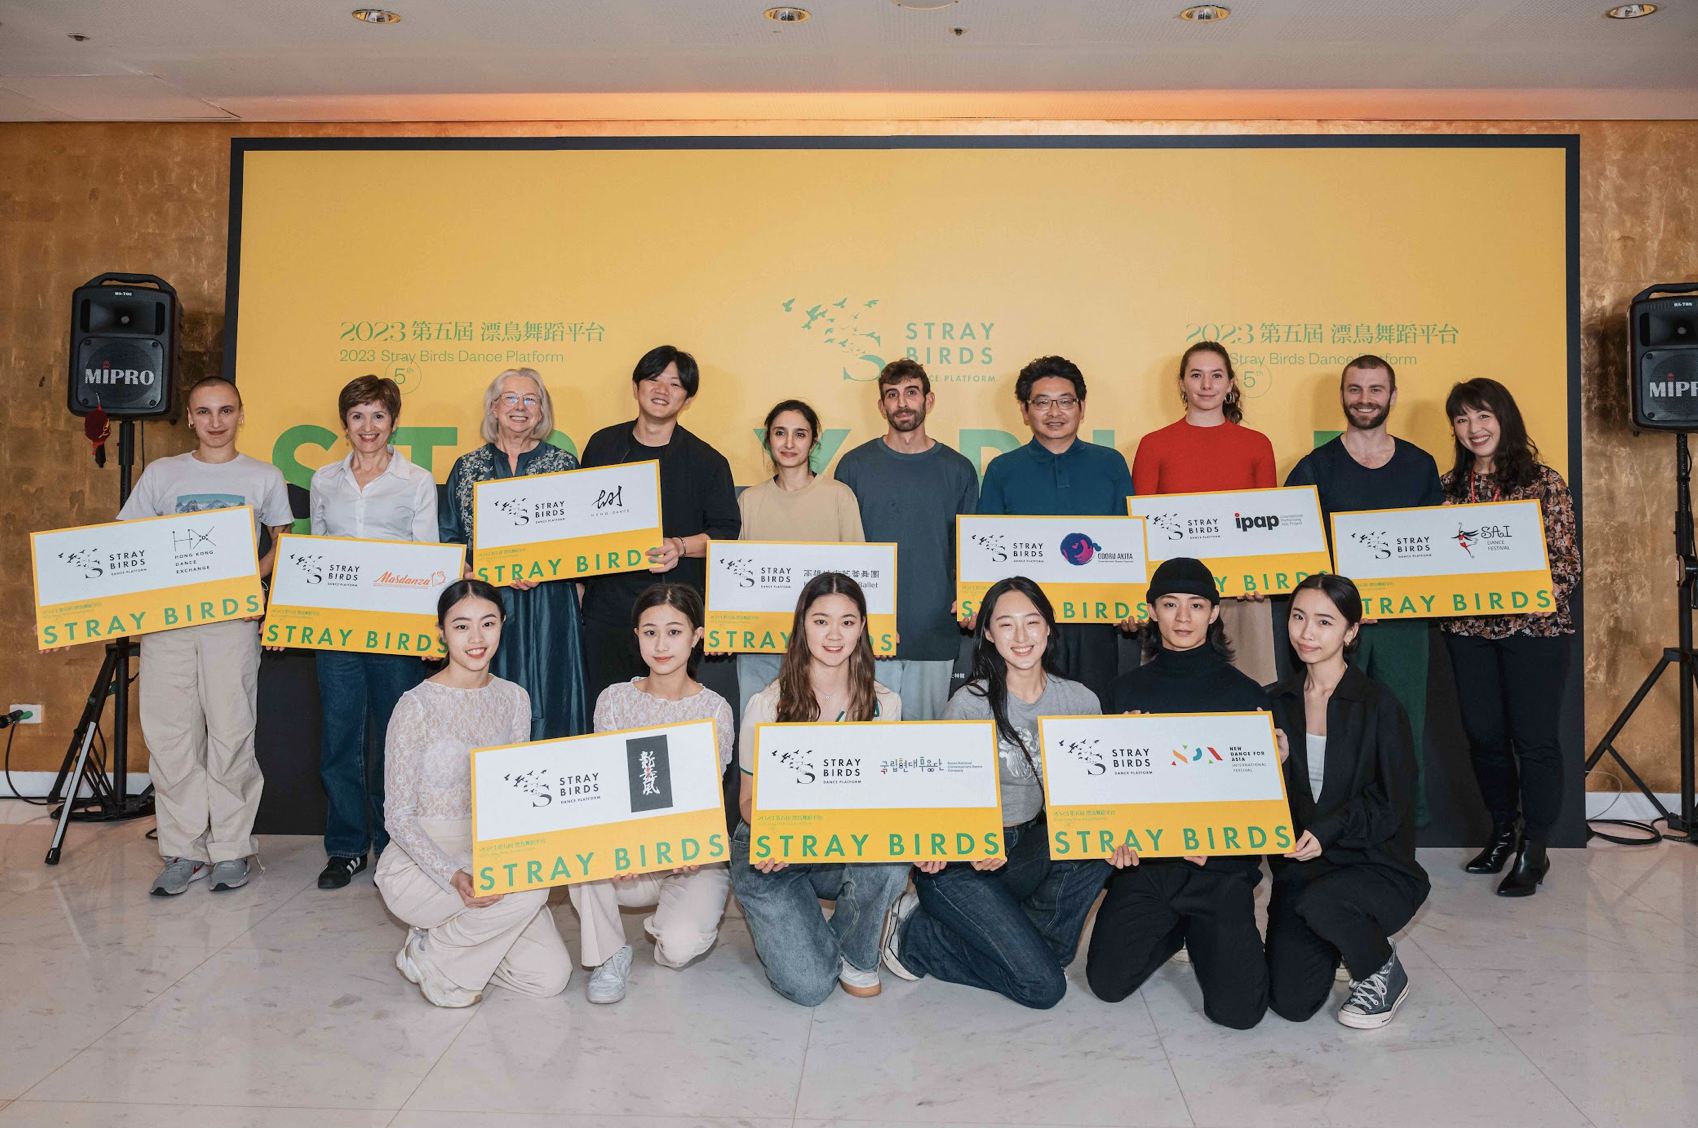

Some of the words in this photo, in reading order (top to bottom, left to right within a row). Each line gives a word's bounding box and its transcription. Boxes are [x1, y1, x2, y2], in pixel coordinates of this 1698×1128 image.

[340, 321, 406, 342] 2023
[411, 320, 474, 342] 第五屆
[481, 321, 606, 343] 漂鳥舞蹈平台
[905, 322, 995, 340] STRAY
[1260, 323, 1323, 345] 第五屆
[1331, 323, 1459, 345] 漂鳥舞蹈平台
[340, 350, 376, 362] 2023
[381, 350, 417, 364] Stray
[420, 350, 455, 362] Birds
[458, 350, 503, 362] Dance
[506, 350, 564, 362] Platform
[906, 346, 993, 365] BIRDS
[1230, 352, 1266, 366] Stray
[1269, 353, 1305, 365] Birds
[1309, 353, 1354, 365] Dance
[535, 501, 565, 510] STRAY
[535, 509, 565, 518] BIRDS
[1187, 518, 1218, 526] STRAY
[1234, 512, 1279, 532] ipap
[1188, 526, 1219, 534] BIRDS
[1481, 525, 1513, 539] SAI
[1397, 536, 1430, 545] STRAY
[109, 550, 145, 561] STRAY
[1397, 544, 1430, 553] BIRDS
[174, 552, 193, 560] HONG
[110, 559, 146, 570] BIRDS
[176, 565, 210, 574] EXCHANGE
[329, 564, 360, 573] STRAY
[478, 558, 562, 583] STRAY
[328, 572, 358, 581] BIRDS
[373, 571, 430, 585] Masdanza
[1361, 595, 1435, 615] TRAY
[1453, 589, 1551, 611] BIRDS
[1063, 602, 1148, 619] BIRDS
[43, 611, 146, 645] STRAY
[164, 594, 259, 625] BIRDS
[266, 624, 353, 647] STRAY
[366, 630, 449, 653] BIRDS
[708, 630, 792, 649] STRAY
[1112, 748, 1150, 757] STRAY
[823, 758, 861, 767] STRAY
[1113, 758, 1151, 768] BIRDS
[559, 772, 600, 786] STRAY
[823, 768, 861, 777] BIRDS
[560, 784, 599, 797] BIRDS
[755, 833, 869, 858] STRAY
[889, 832, 999, 856] BIRDS
[1055, 828, 1164, 854] STRAY
[1183, 825, 1291, 850] BIRDS
[479, 852, 595, 891] STRAY
[615, 833, 724, 871] BIRDS
